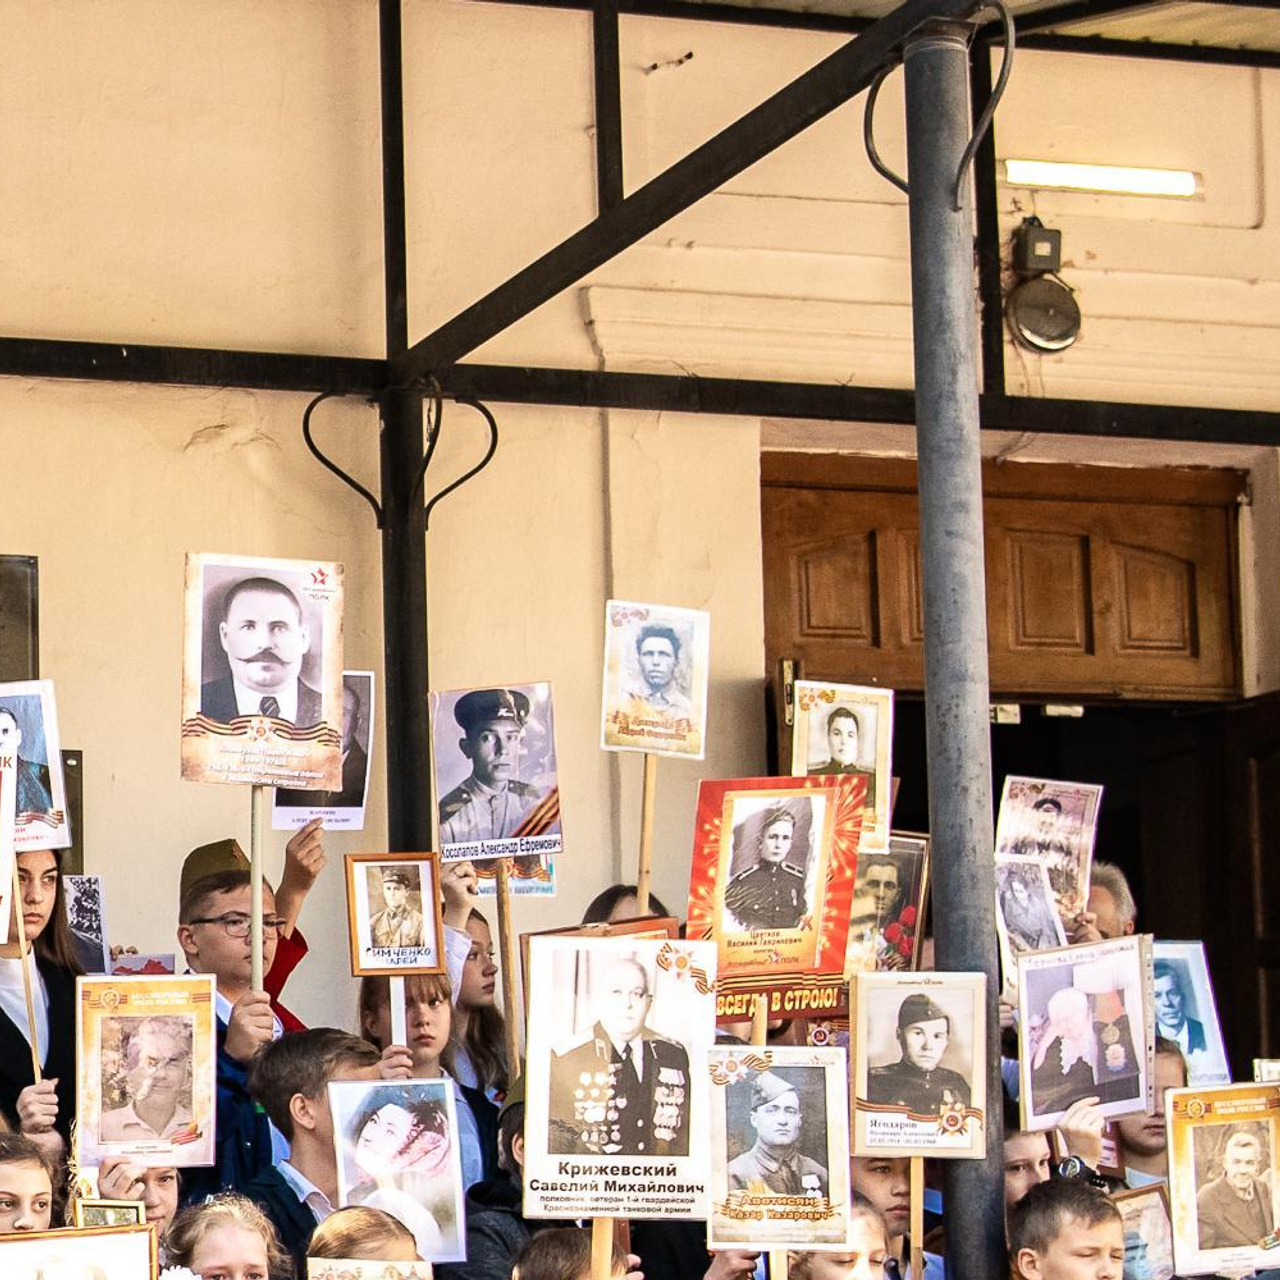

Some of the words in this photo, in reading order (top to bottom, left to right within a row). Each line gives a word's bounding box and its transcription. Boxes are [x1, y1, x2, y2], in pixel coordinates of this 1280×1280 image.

[440, 844, 480, 859] Косолапов
[480, 841, 519, 857] Александр
[519, 838, 561, 854] Ефремович
[726, 939, 758, 948] Василий
[716, 992, 767, 1018] ВСЕГД
[771, 992, 781, 1012] В
[784, 987, 838, 1011] СТРОЮ!
[870, 1119, 918, 1130] Ягодаров
[558, 1161, 678, 1178] Крижевский
[529, 1179, 599, 1193] Савелий
[603, 1180, 706, 1194] Михайлович
[589, 1195, 624, 1204] ветеран
[627, 1195, 640, 1203] 1-й
[641, 1195, 696, 1205] гвардейской
[543, 1203, 620, 1213] Краснознаменной
[622, 1206, 663, 1214] танковой
[663, 1206, 692, 1214] армии
